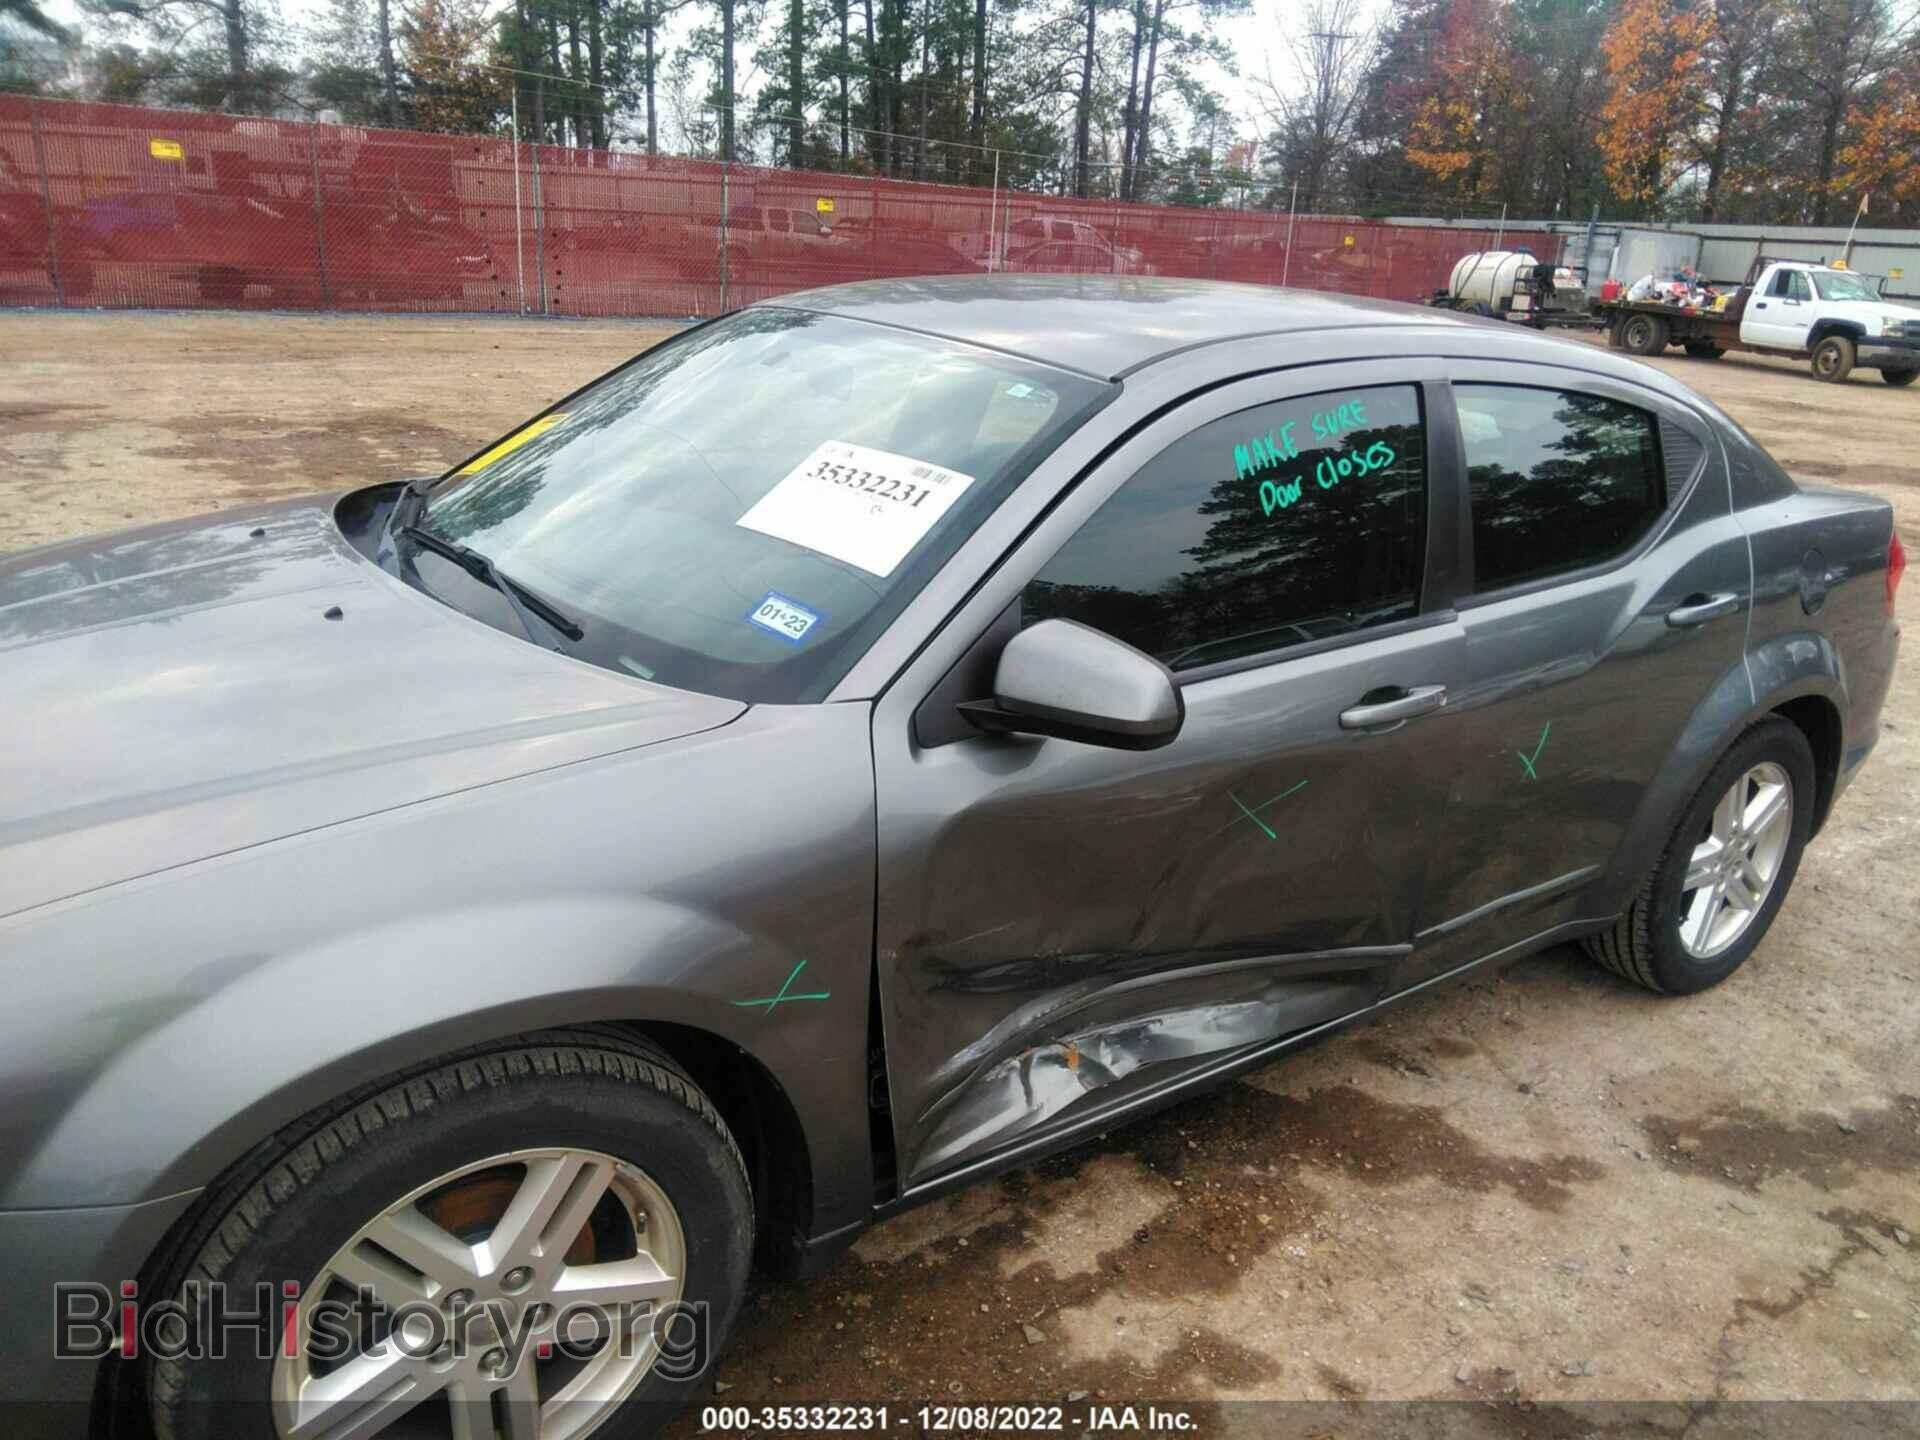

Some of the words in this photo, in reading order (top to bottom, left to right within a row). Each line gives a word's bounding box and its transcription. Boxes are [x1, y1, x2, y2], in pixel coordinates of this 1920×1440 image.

[1233, 420, 1299, 480] MAKE
[1311, 400, 1368, 440] SURE
[806, 461, 931, 507] 35332231
[1259, 475, 1302, 517] Door
